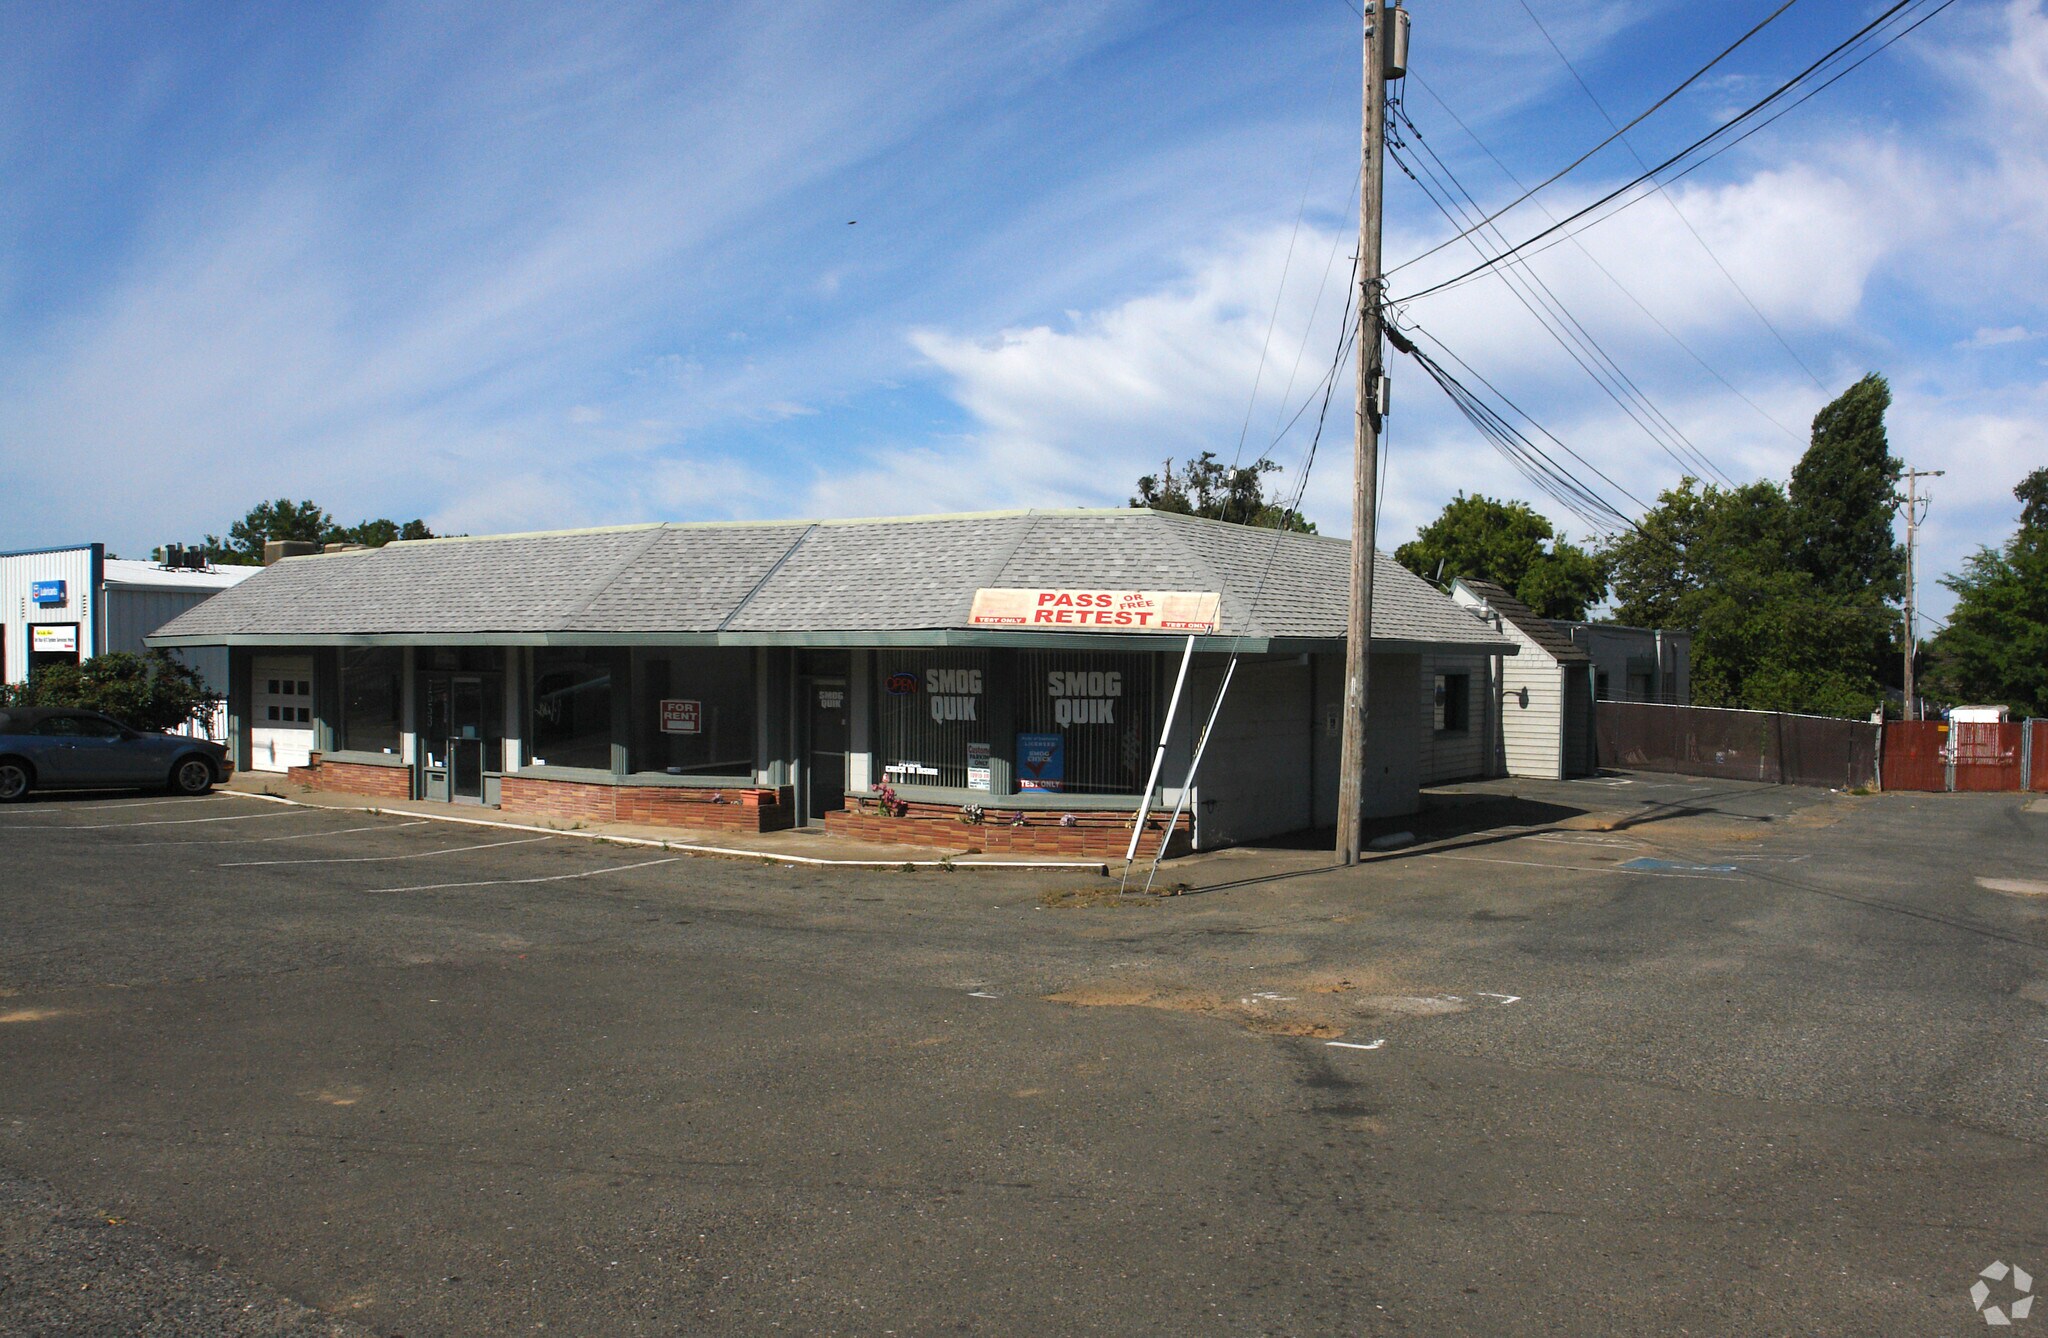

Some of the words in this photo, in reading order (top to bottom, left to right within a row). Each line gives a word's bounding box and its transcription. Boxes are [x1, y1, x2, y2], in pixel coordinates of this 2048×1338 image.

[1037, 593, 1113, 608] PASS
[1123, 594, 1144, 602] OR
[1119, 600, 1155, 610] FREE
[1033, 609, 1154, 626] RETEST
[883, 675, 918, 695] OPEN
[926, 669, 982, 694] SMOG
[1047, 671, 1122, 697] SMOG
[818, 690, 844, 700] SMOG
[667, 703, 694, 712] FOR
[821, 699, 842, 709] QUIK
[930, 695, 977, 725] QUIK
[663, 711, 698, 720] RENT
[1055, 698, 1115, 729] QUIK
[1020, 779, 1040, 788] TEST
[1040, 780, 1060, 788] ONLY
